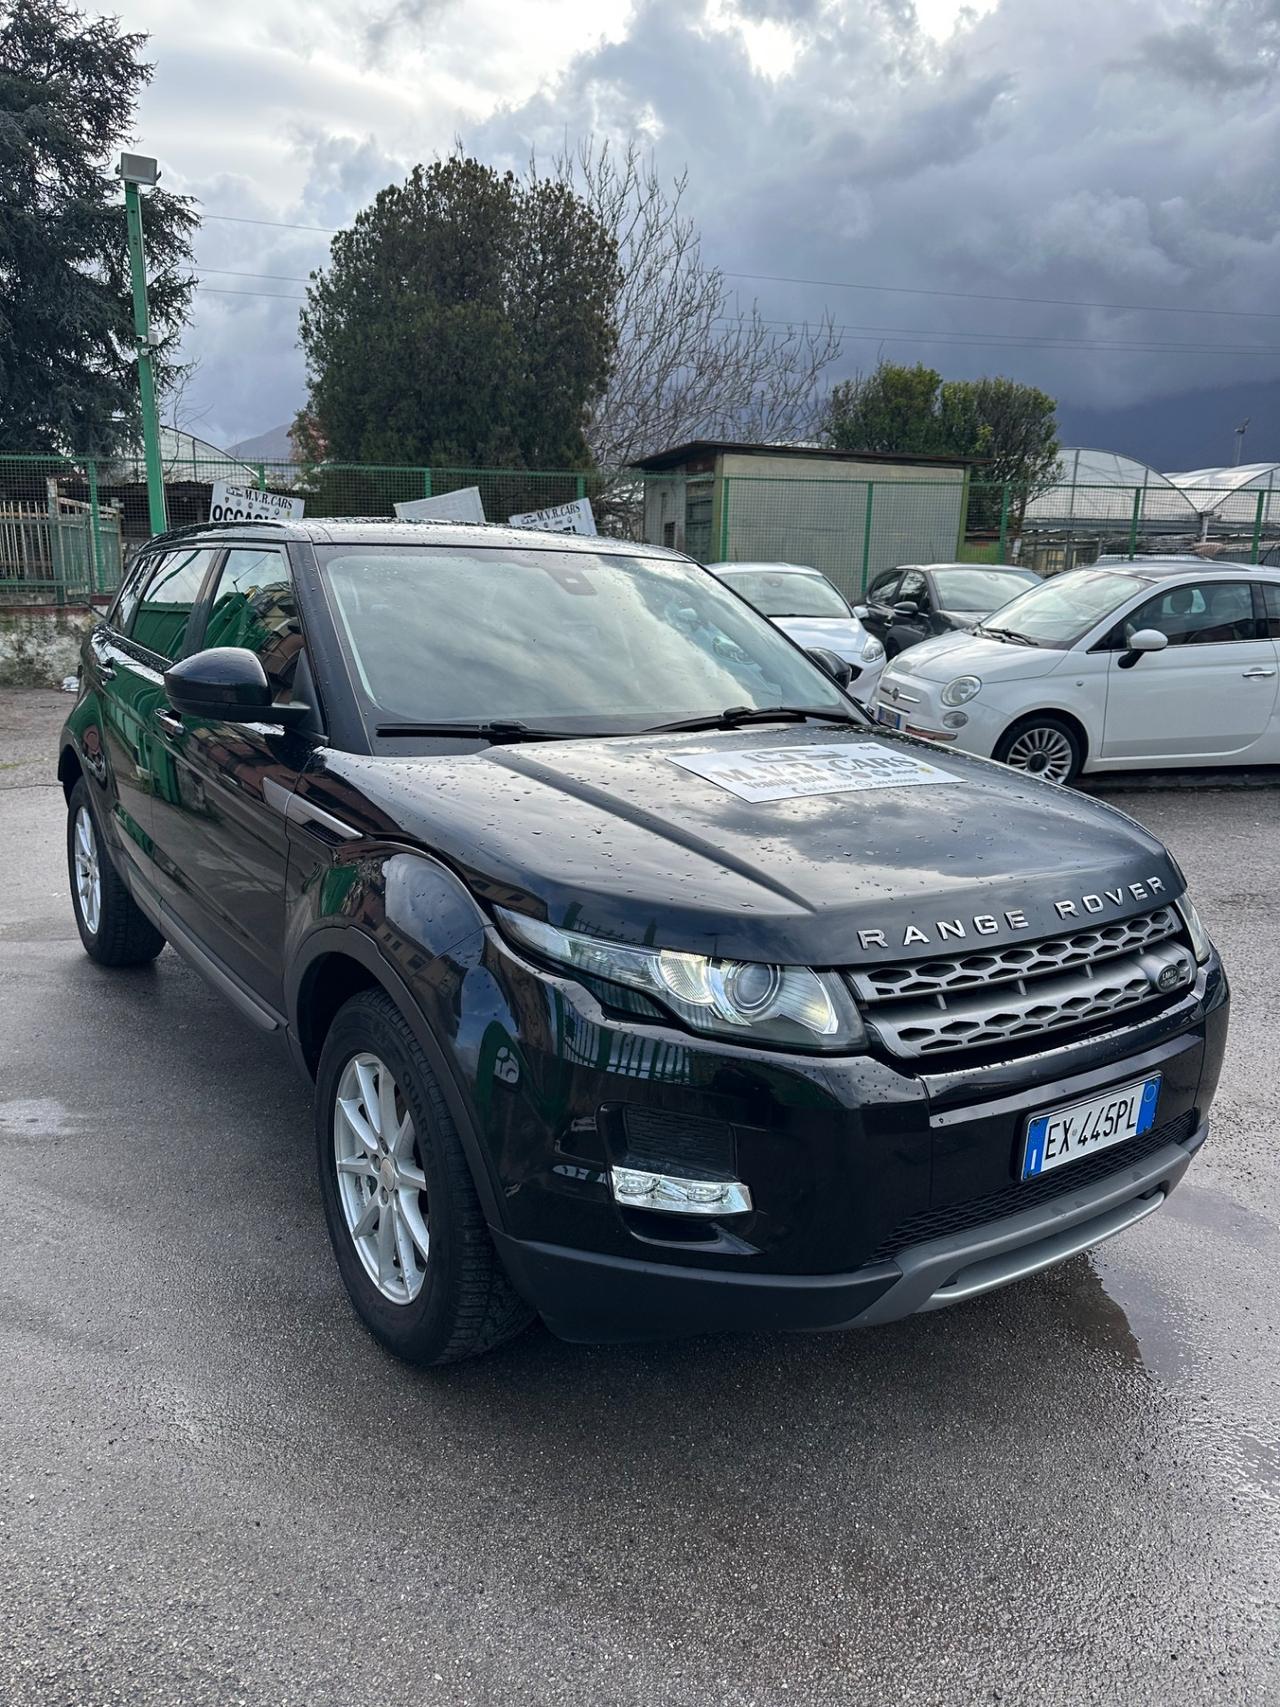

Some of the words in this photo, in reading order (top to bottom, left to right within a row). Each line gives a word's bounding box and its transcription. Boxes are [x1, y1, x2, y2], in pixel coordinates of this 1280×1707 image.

[857, 909, 1029, 949] RANGE
[1054, 876, 1166, 920] ROVER
[1045, 1117, 1074, 1160] EX
[1077, 1096, 1136, 1147] 445PL
